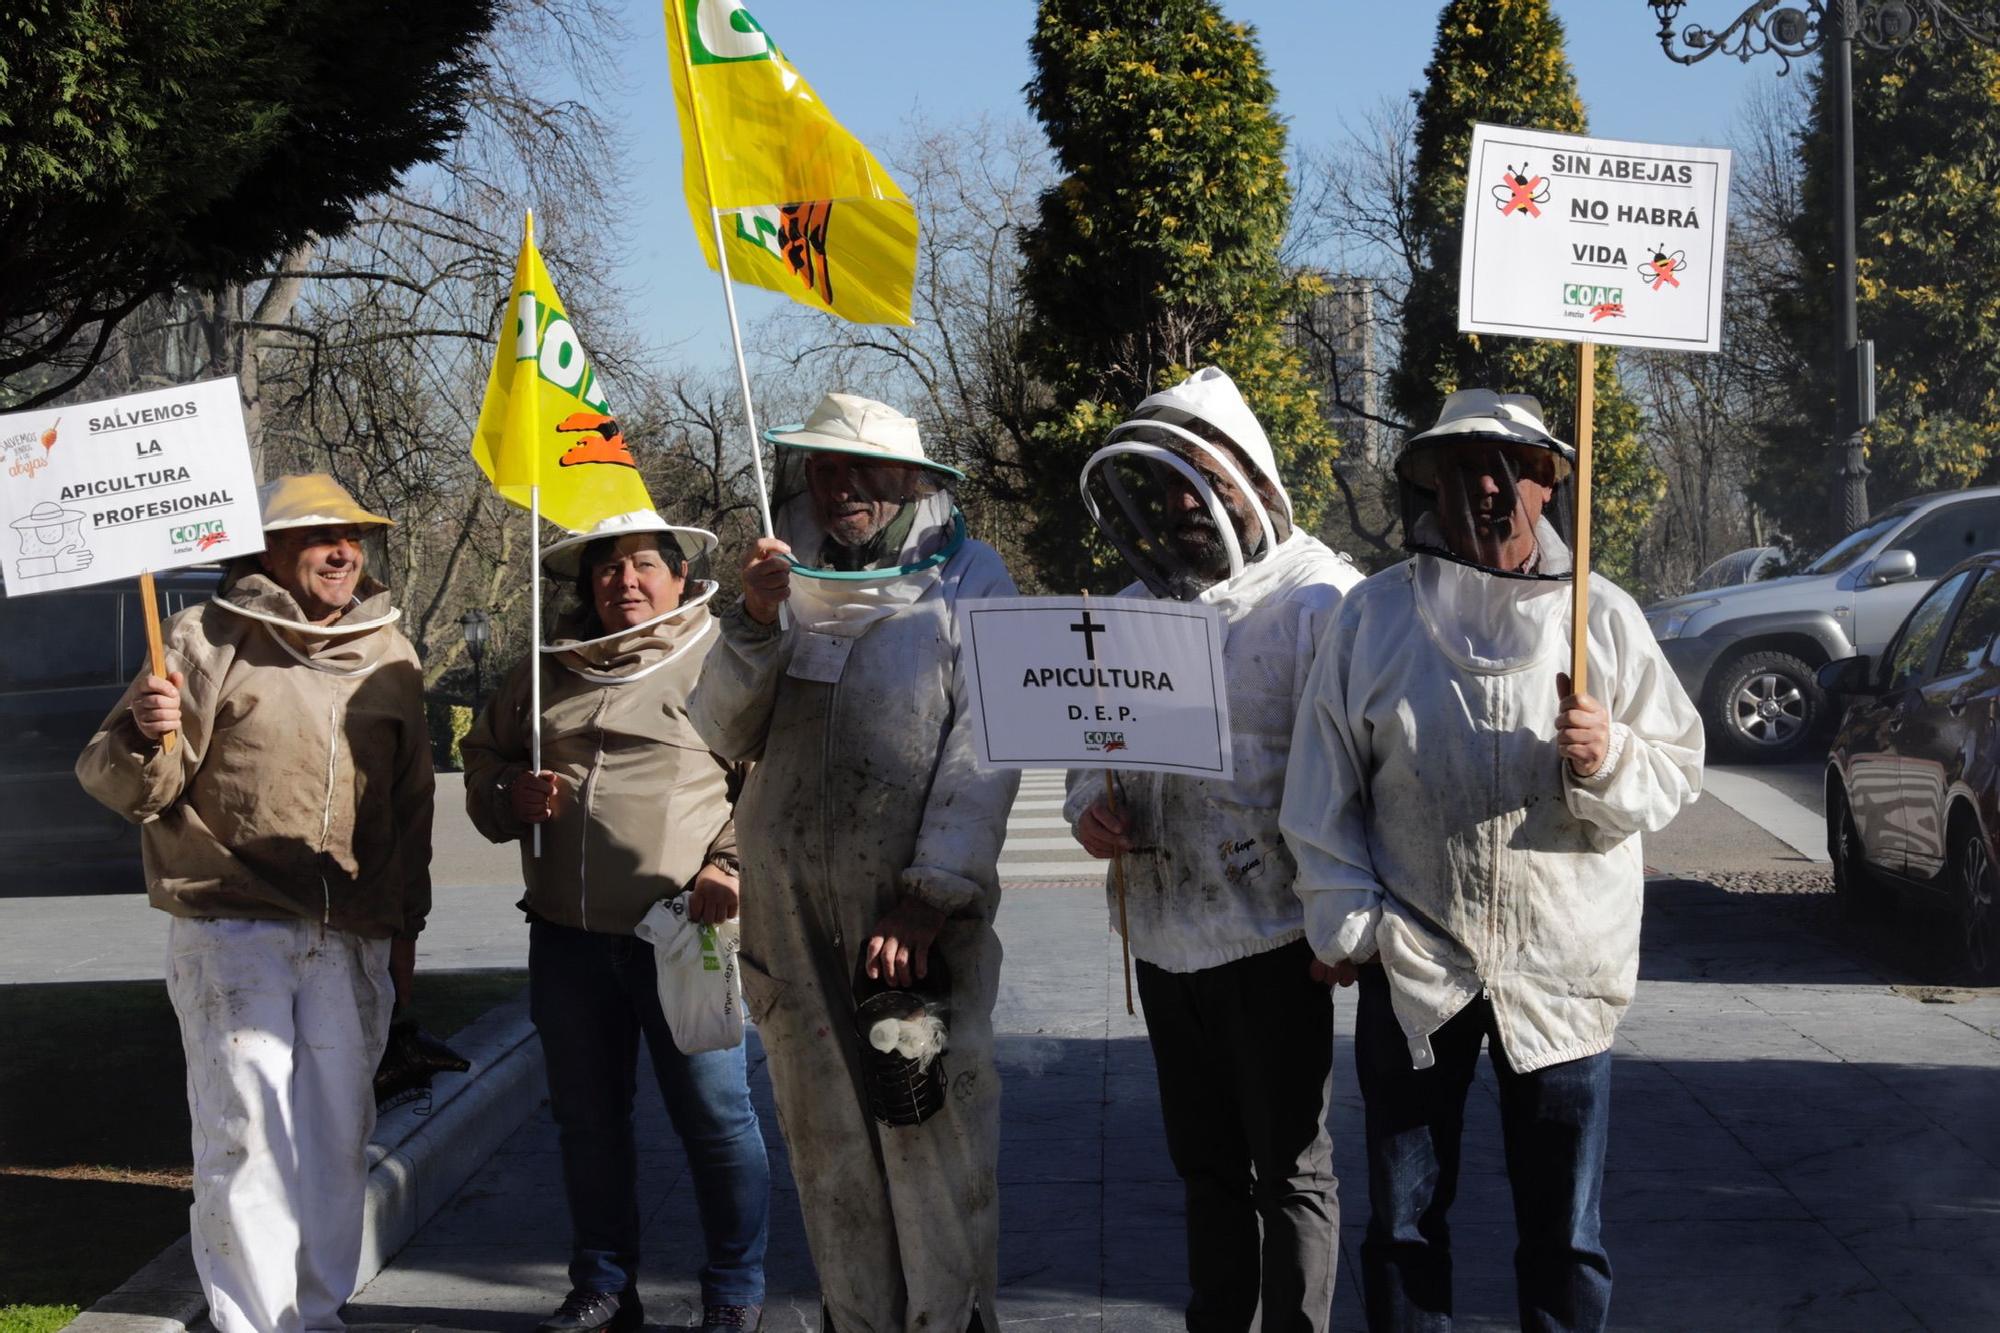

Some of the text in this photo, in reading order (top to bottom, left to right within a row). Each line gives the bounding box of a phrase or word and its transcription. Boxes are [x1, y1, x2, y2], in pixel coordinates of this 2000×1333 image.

[1552, 153, 1693, 184] SIN ABEJAS
[1570, 198, 1700, 229] NO HABRÁ
[1572, 244, 1628, 265] VIDA
[1564, 284, 1622, 306] COAG
[89, 401, 198, 432] SALVEMOS
[136, 439, 162, 456] LA
[60, 466, 190, 500] APICULTURA
[93, 489, 234, 527] PROFESIONAL
[170, 520, 223, 545] COAG
[1022, 667, 1174, 691] APICULTURA
[1085, 732, 1125, 745] COAG
